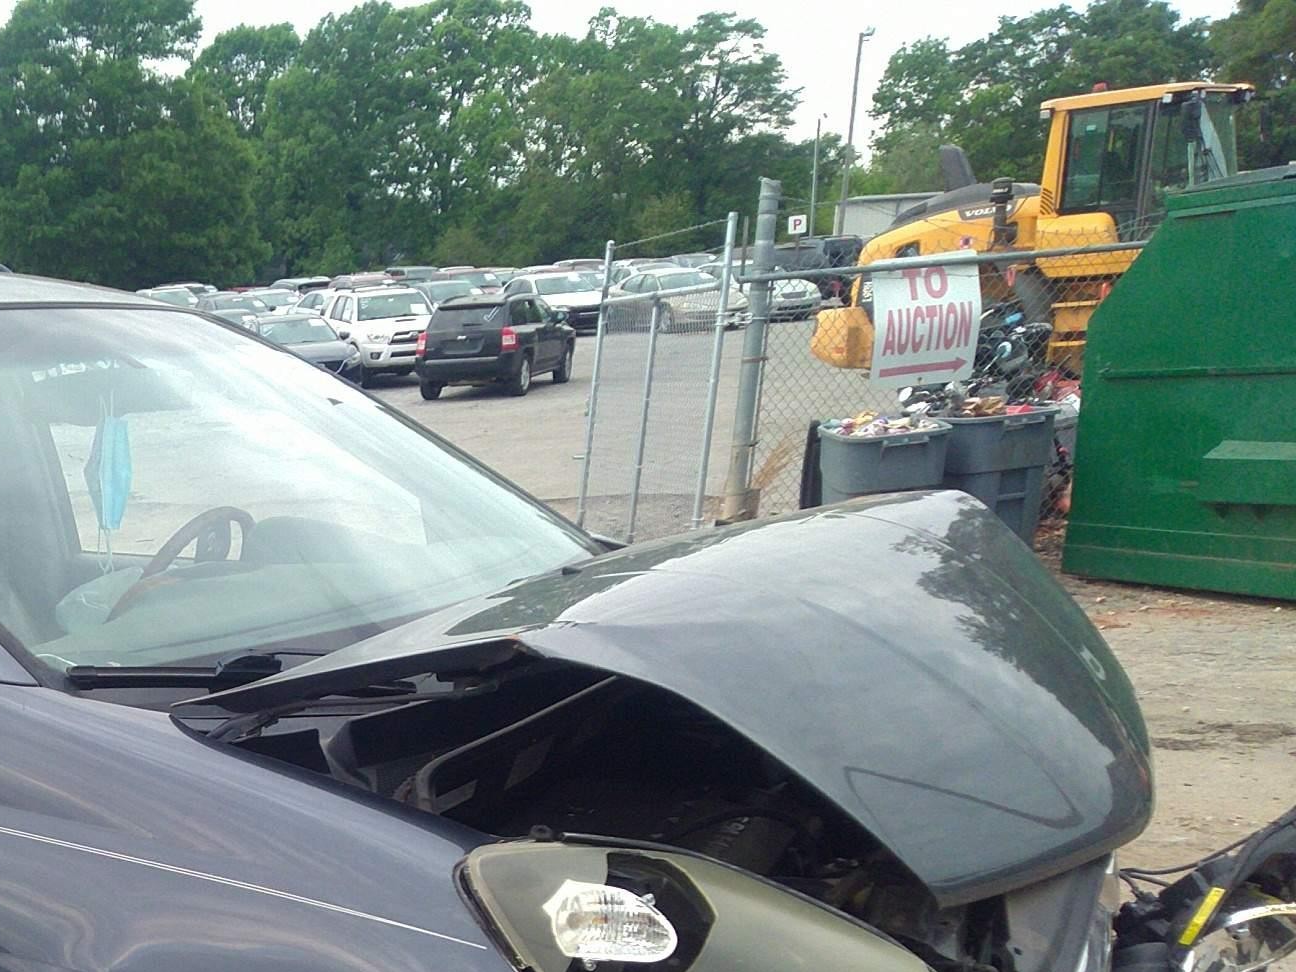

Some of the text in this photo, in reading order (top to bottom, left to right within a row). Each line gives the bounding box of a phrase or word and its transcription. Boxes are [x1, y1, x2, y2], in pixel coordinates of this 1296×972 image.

[793, 218, 802, 231] P
[901, 266, 949, 301] TO
[881, 301, 973, 355] AUCTION
